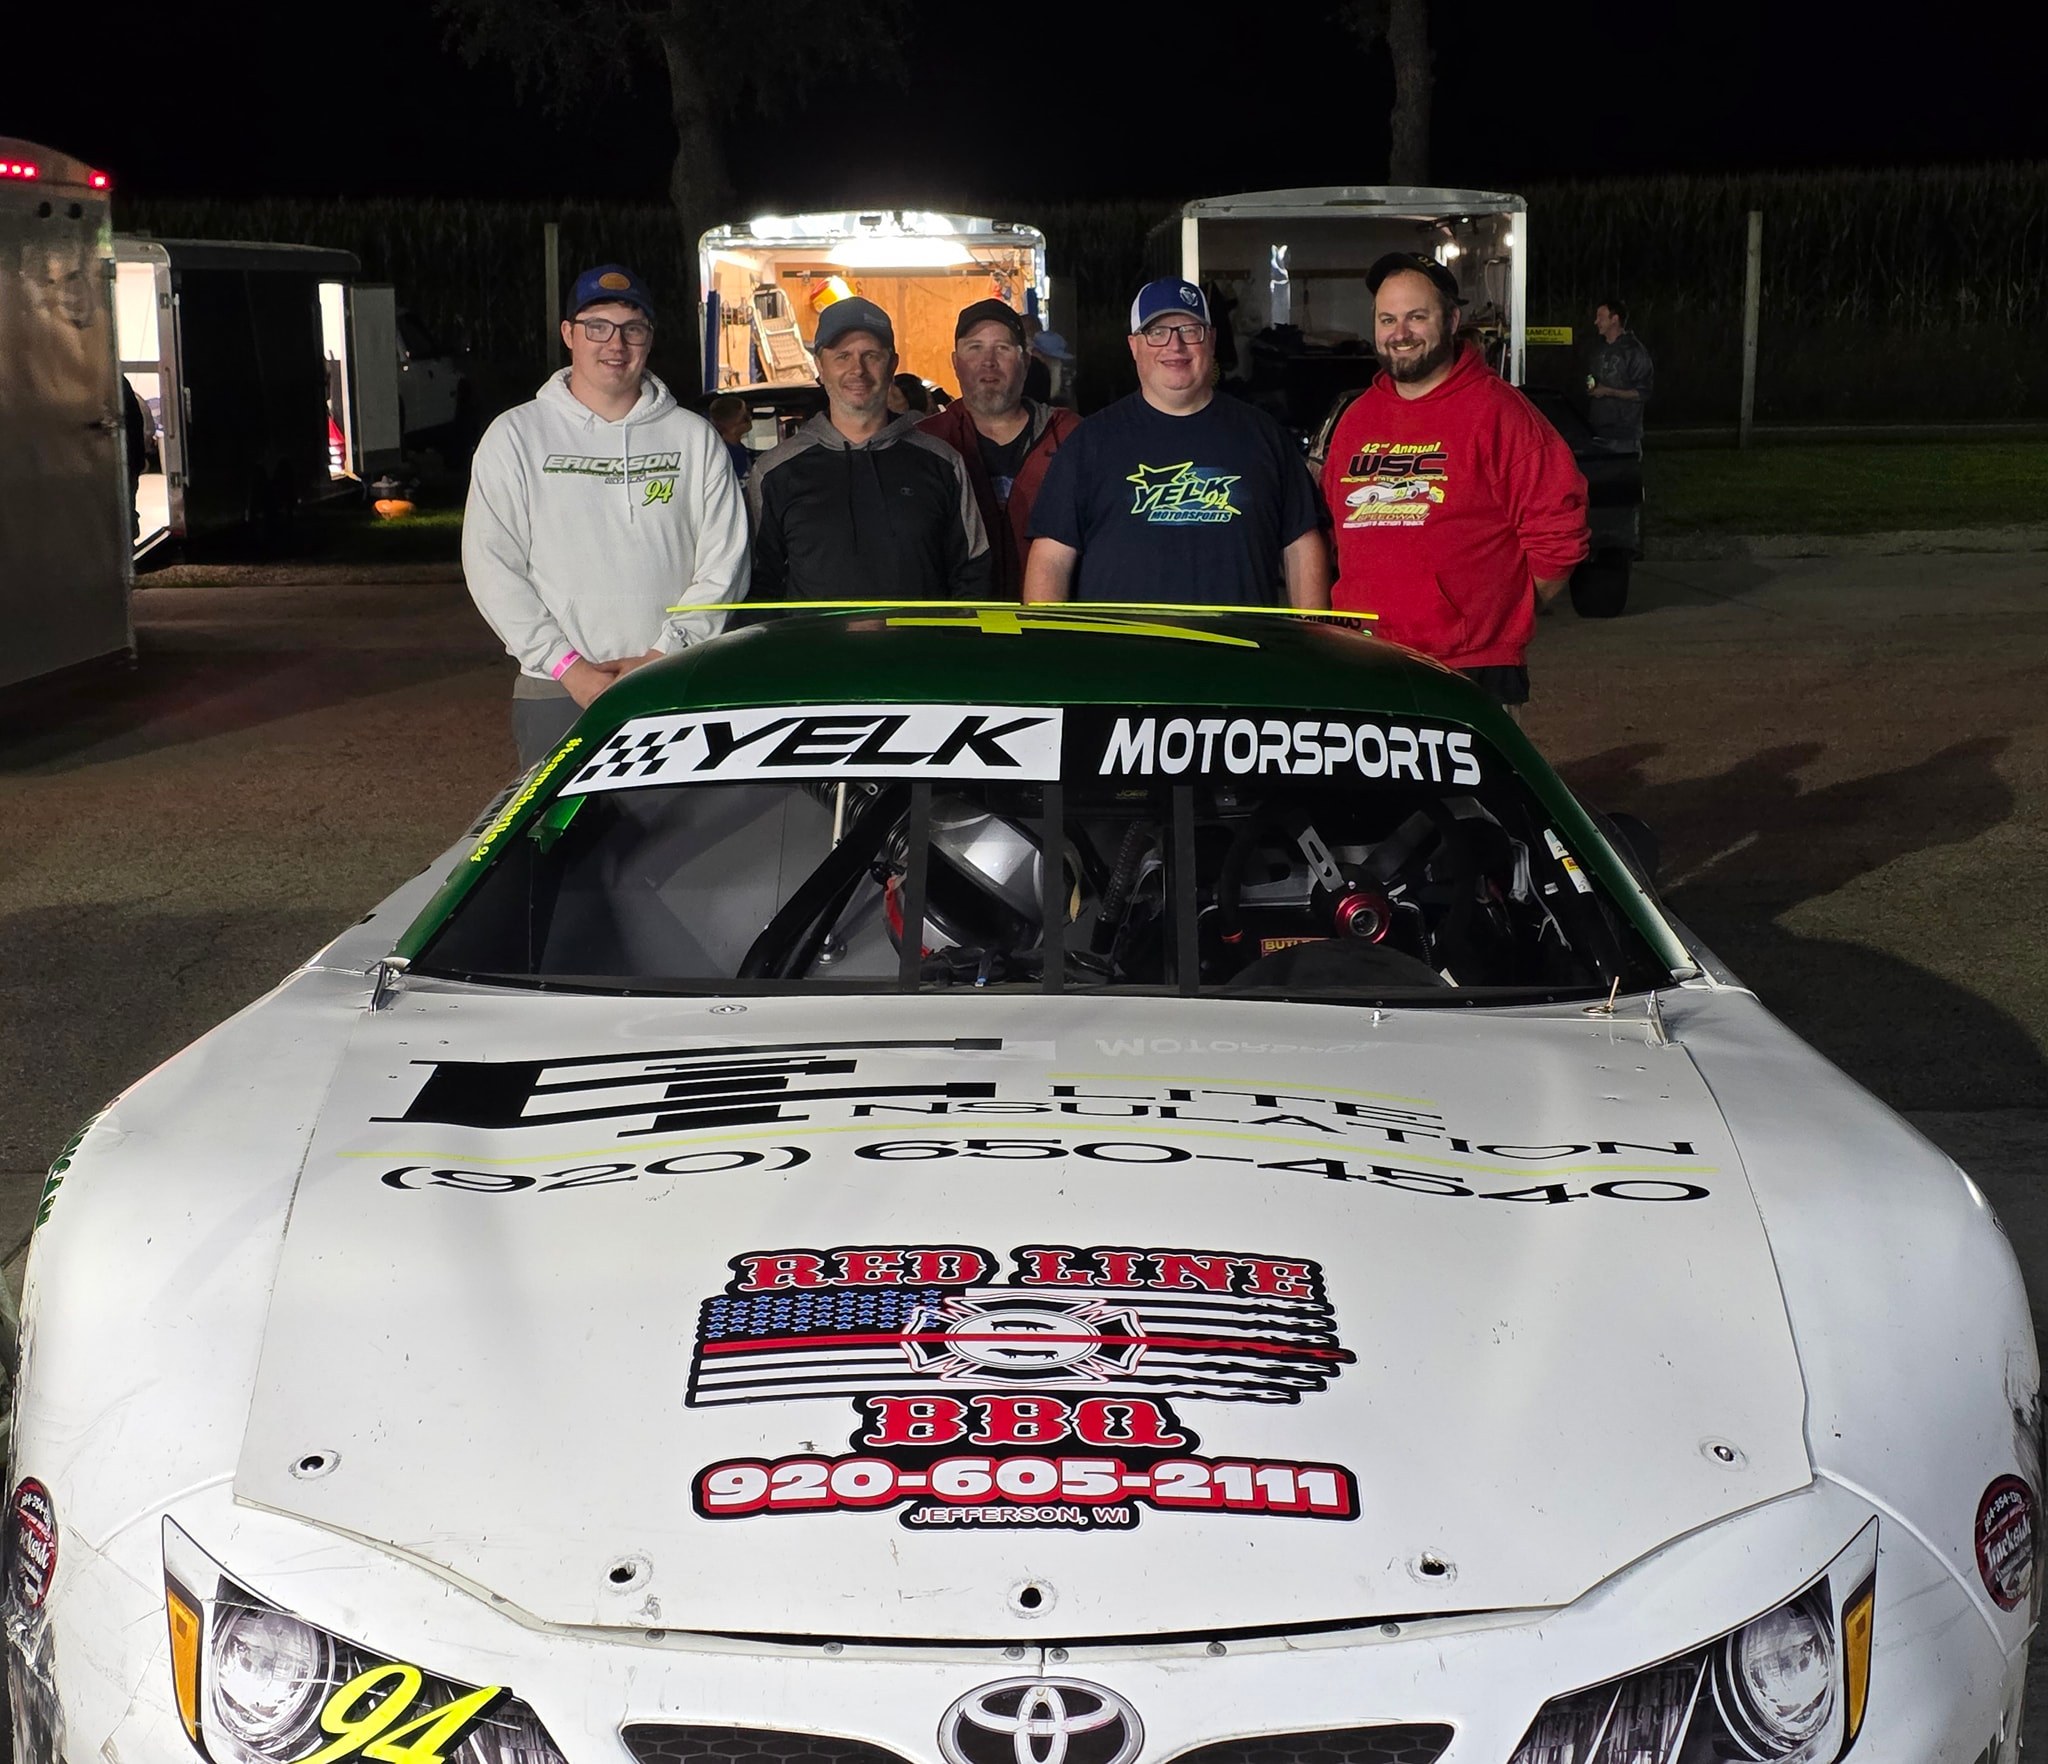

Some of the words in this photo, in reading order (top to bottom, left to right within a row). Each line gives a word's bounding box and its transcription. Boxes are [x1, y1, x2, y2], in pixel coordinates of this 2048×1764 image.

[1389, 442, 1441, 454] Annual
[543, 453, 681, 475] ERICKSON
[1348, 453, 1448, 477] WSC
[642, 478, 675, 506] 94
[1131, 475, 1242, 514] YELK
[1200, 489, 1232, 510] 94
[1148, 510, 1232, 523] MOTORSPORTS
[1345, 502, 1430, 521] Jefferson
[691, 715, 1053, 771] YELK
[1098, 717, 1482, 785] MOTORSPORTS
[380, 1146, 812, 1193] (920)
[854, 1139, 1711, 1205] 650-4540
[737, 1250, 984, 1291] RED
[1023, 1250, 1314, 1300] LINE
[863, 1396, 1188, 1448] BBQ
[704, 1458, 1346, 1510] 920-605-2111
[908, 1505, 1088, 1525] JEFFERSON,
[1094, 1507, 1130, 1525] WI
[290, 1664, 503, 1764] 94
